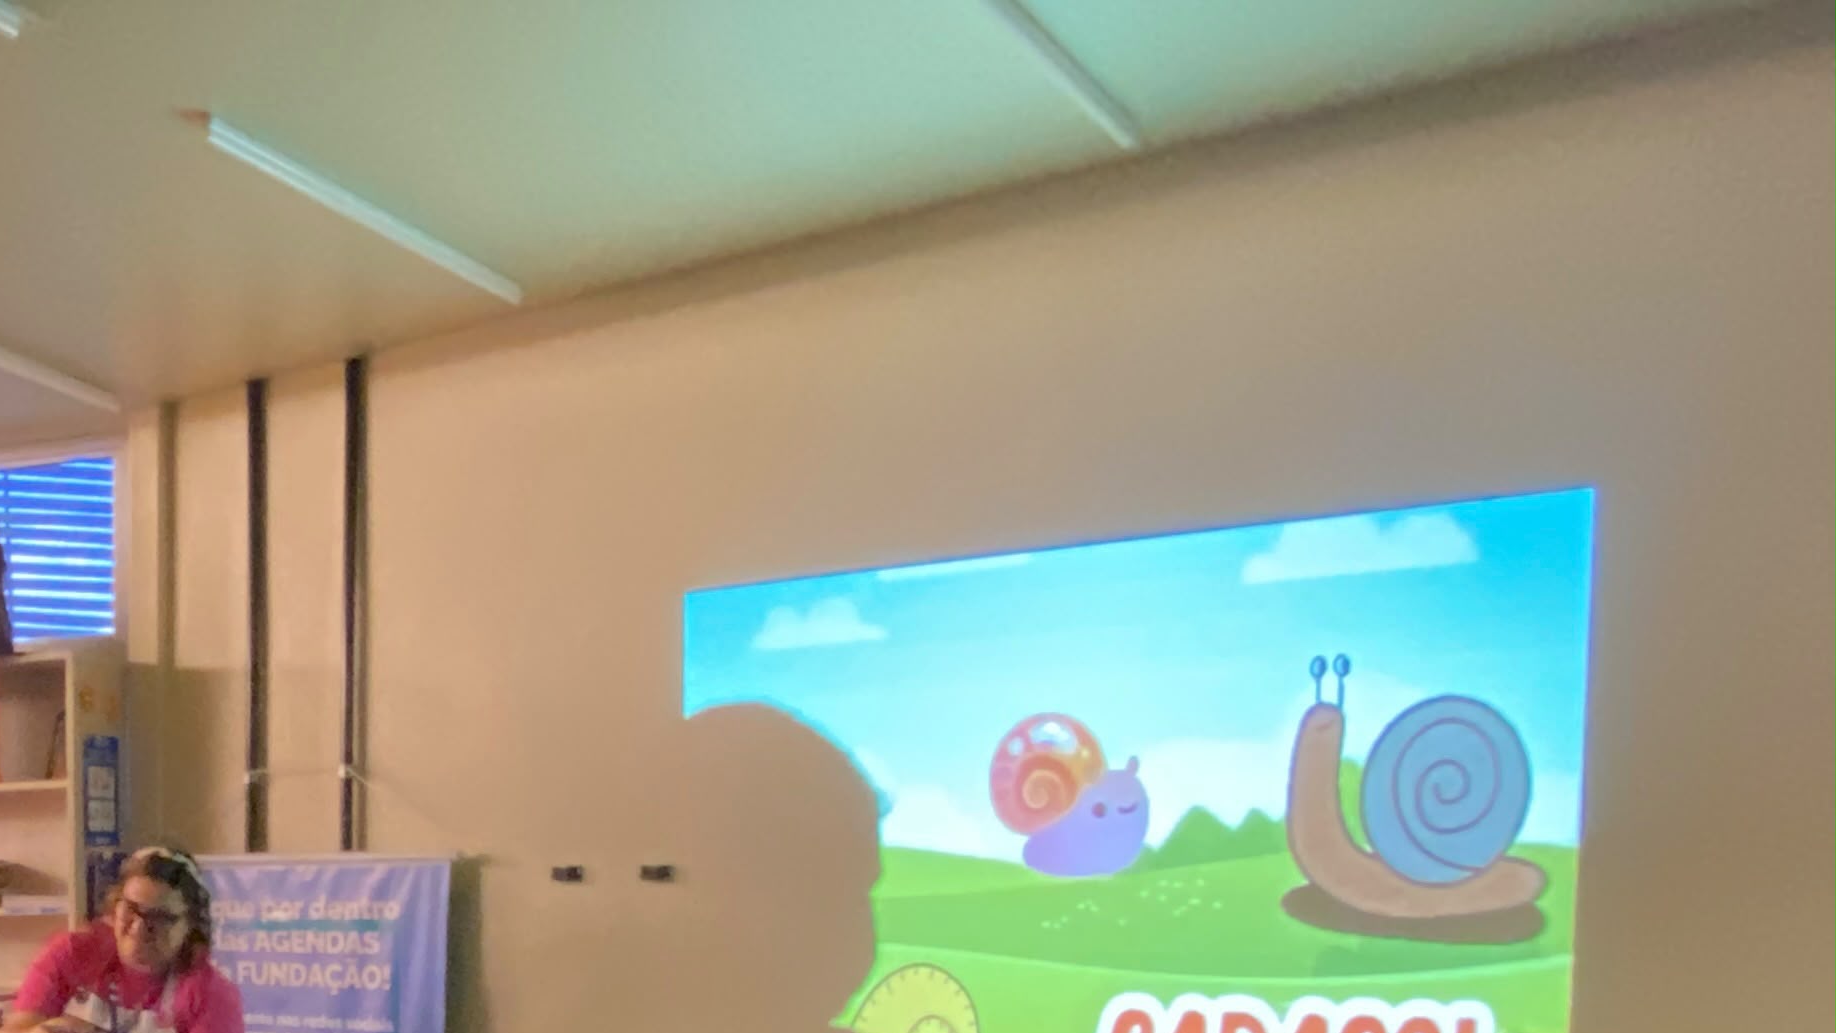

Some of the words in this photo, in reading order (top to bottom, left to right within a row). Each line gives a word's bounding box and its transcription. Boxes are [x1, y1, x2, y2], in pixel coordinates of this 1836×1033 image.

[260, 900, 303, 923] por
[308, 895, 401, 921] dentro
[253, 929, 381, 955] AGENDAS
[236, 958, 392, 995] FUNDAÇÃO!
